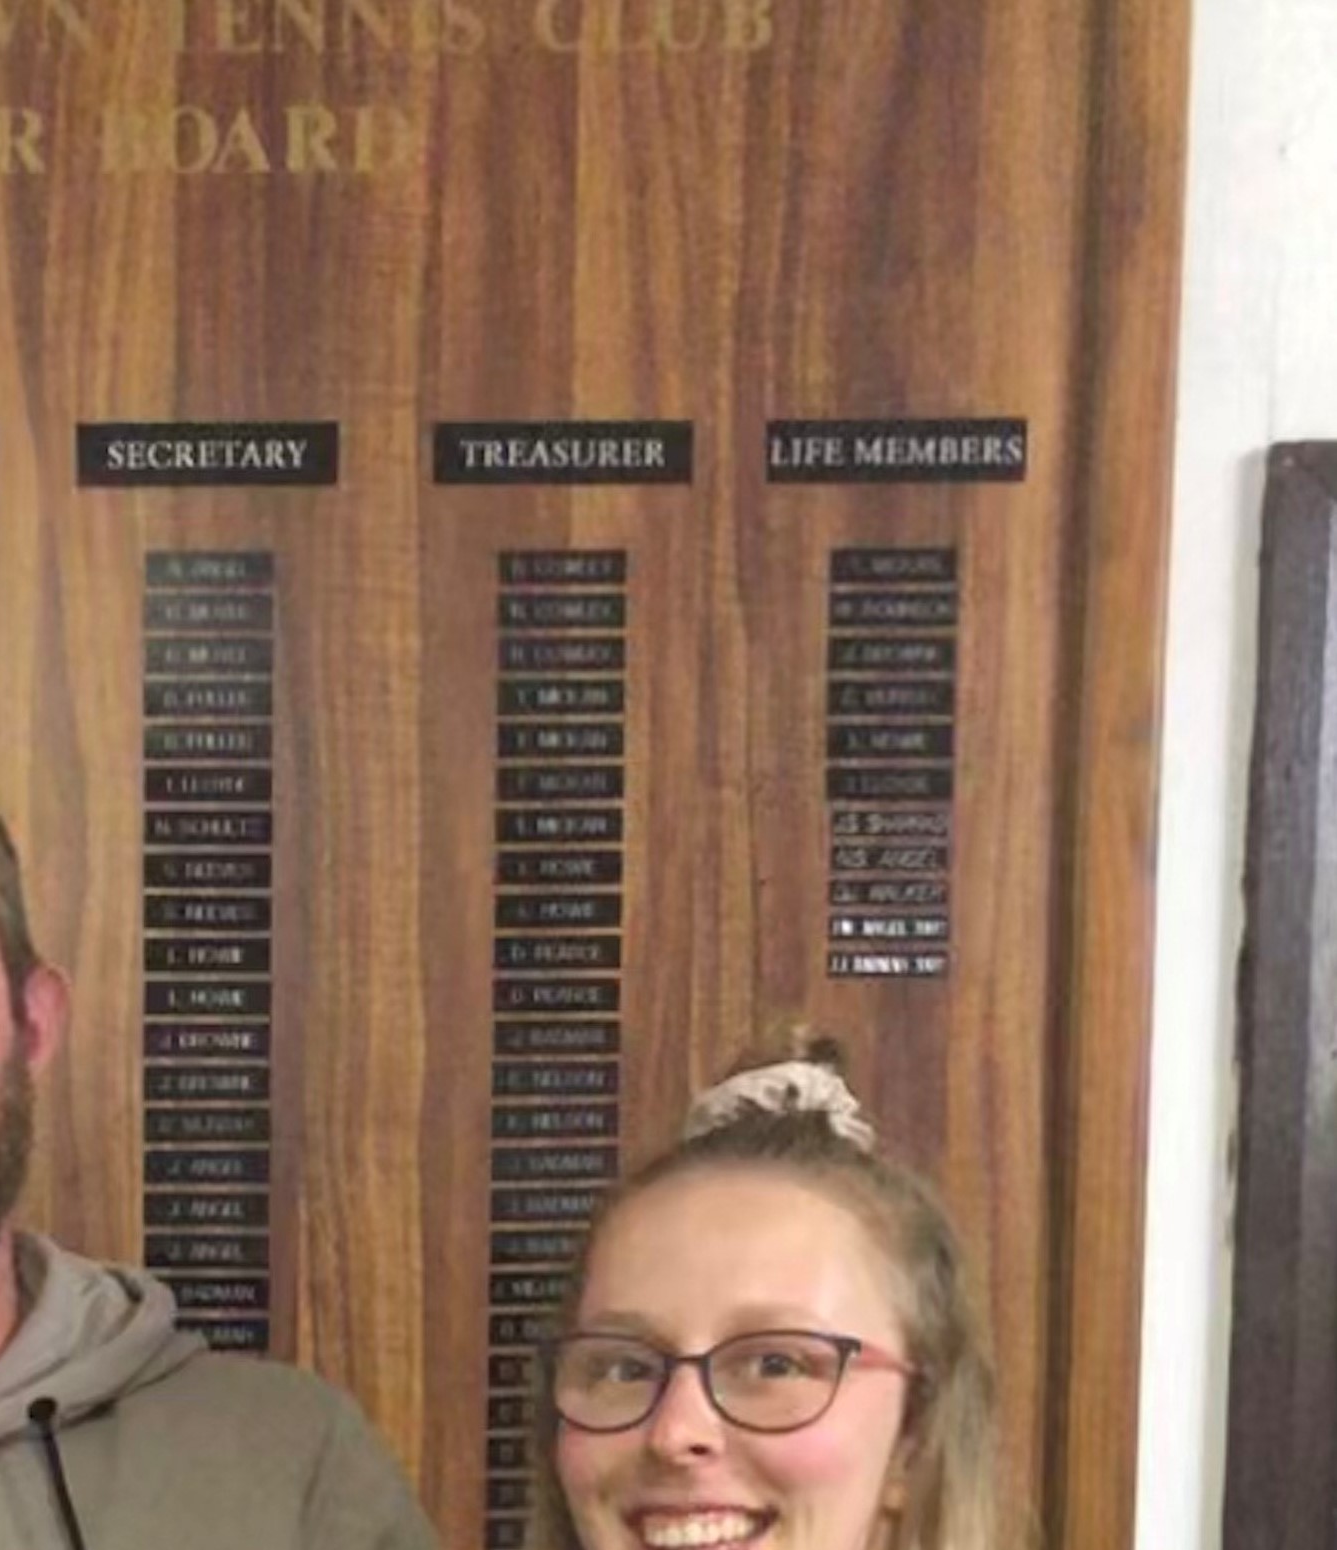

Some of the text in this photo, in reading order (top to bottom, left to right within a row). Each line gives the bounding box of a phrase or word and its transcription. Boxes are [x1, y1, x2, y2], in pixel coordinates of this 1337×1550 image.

[537, 0, 774, 53] CLUB
[102, 102, 419, 175] BOARD
[105, 439, 308, 471] SECRETARY
[460, 438, 665, 469] TREASURER
[768, 436, 1024, 468] LIFE MEMBERS
